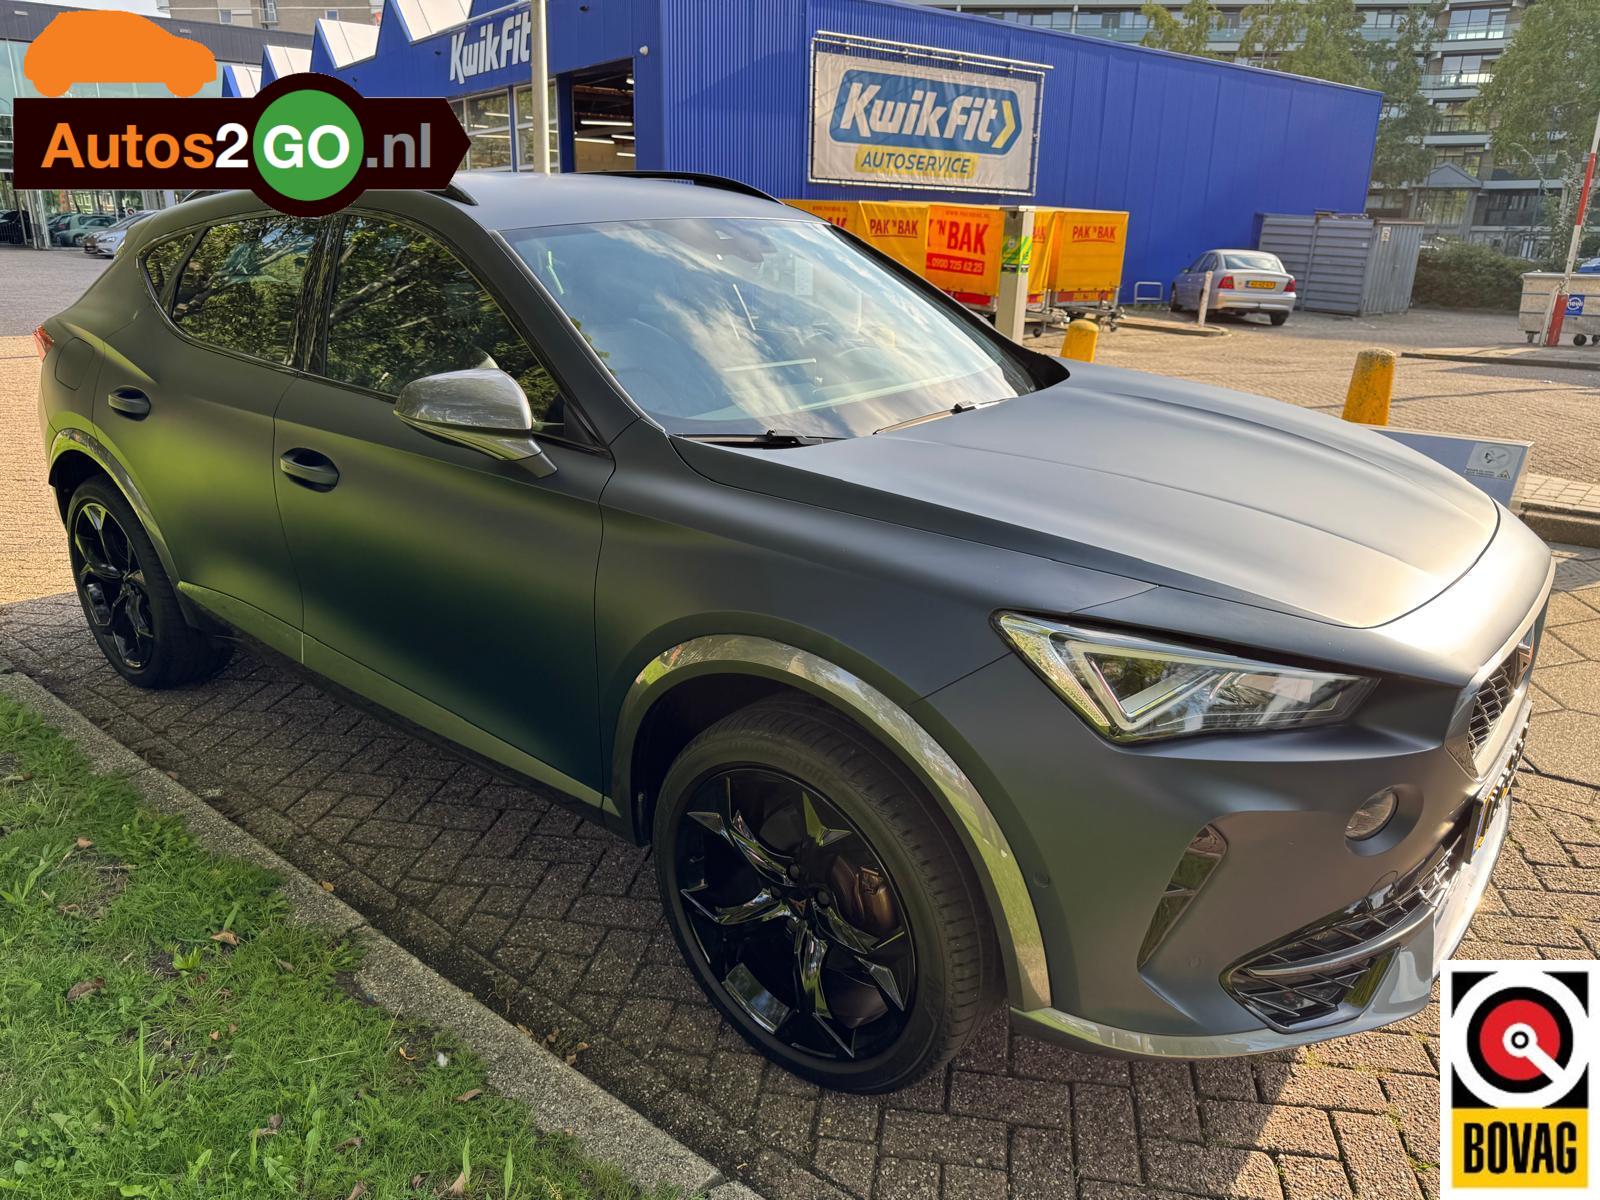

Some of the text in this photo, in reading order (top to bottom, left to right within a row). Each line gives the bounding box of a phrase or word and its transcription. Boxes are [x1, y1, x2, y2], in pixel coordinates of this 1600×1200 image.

[861, 151, 972, 173] AUTOSERVICE
[870, 219, 890, 234] PAK
[897, 220, 919, 235] BAK
[1072, 226, 1092, 240] PAK
[1097, 226, 1117, 240] BAK
[947, 221, 989, 255] BAK
